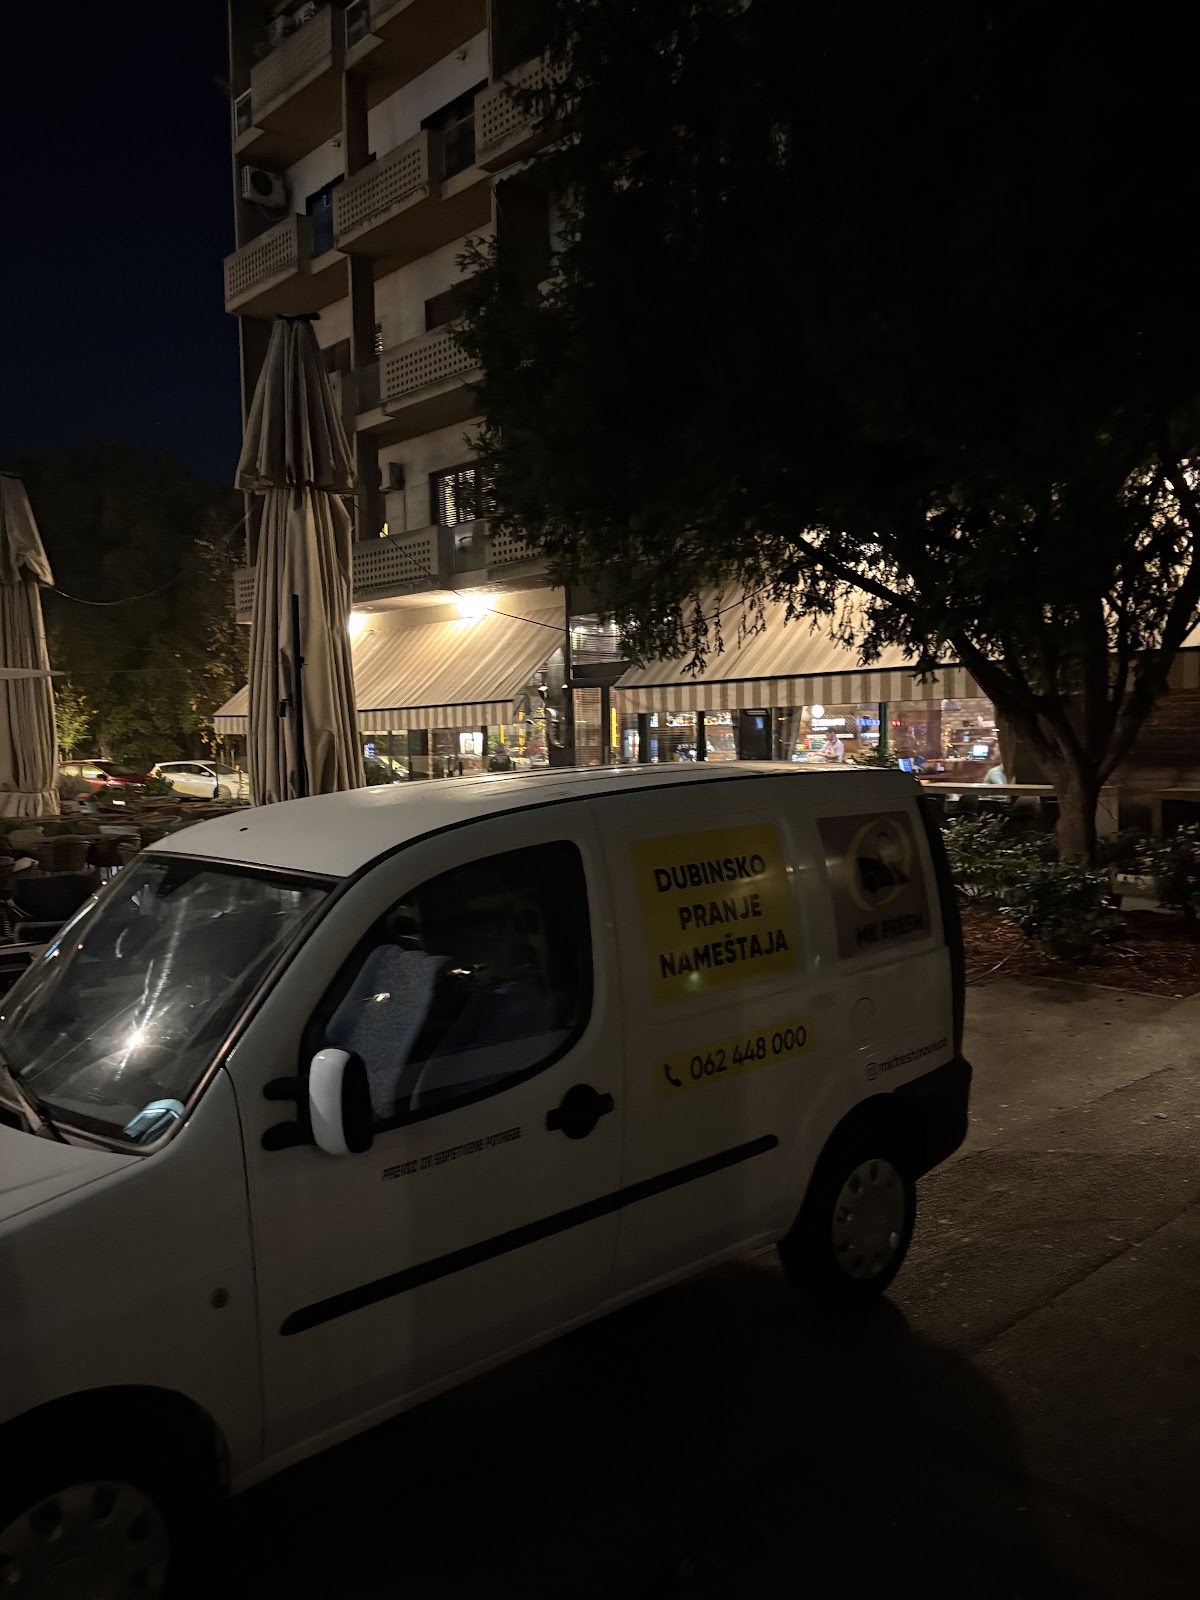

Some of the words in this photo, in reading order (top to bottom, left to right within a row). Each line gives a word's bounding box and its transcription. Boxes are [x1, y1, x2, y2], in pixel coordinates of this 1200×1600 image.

[653, 854, 766, 893] DUBINSKO
[678, 893, 762, 931] PRANJE
[659, 928, 790, 979] NAMEŠTAJA
[690, 1048, 727, 1081] 062
[732, 1036, 767, 1066] 448
[772, 1025, 807, 1055] 000
